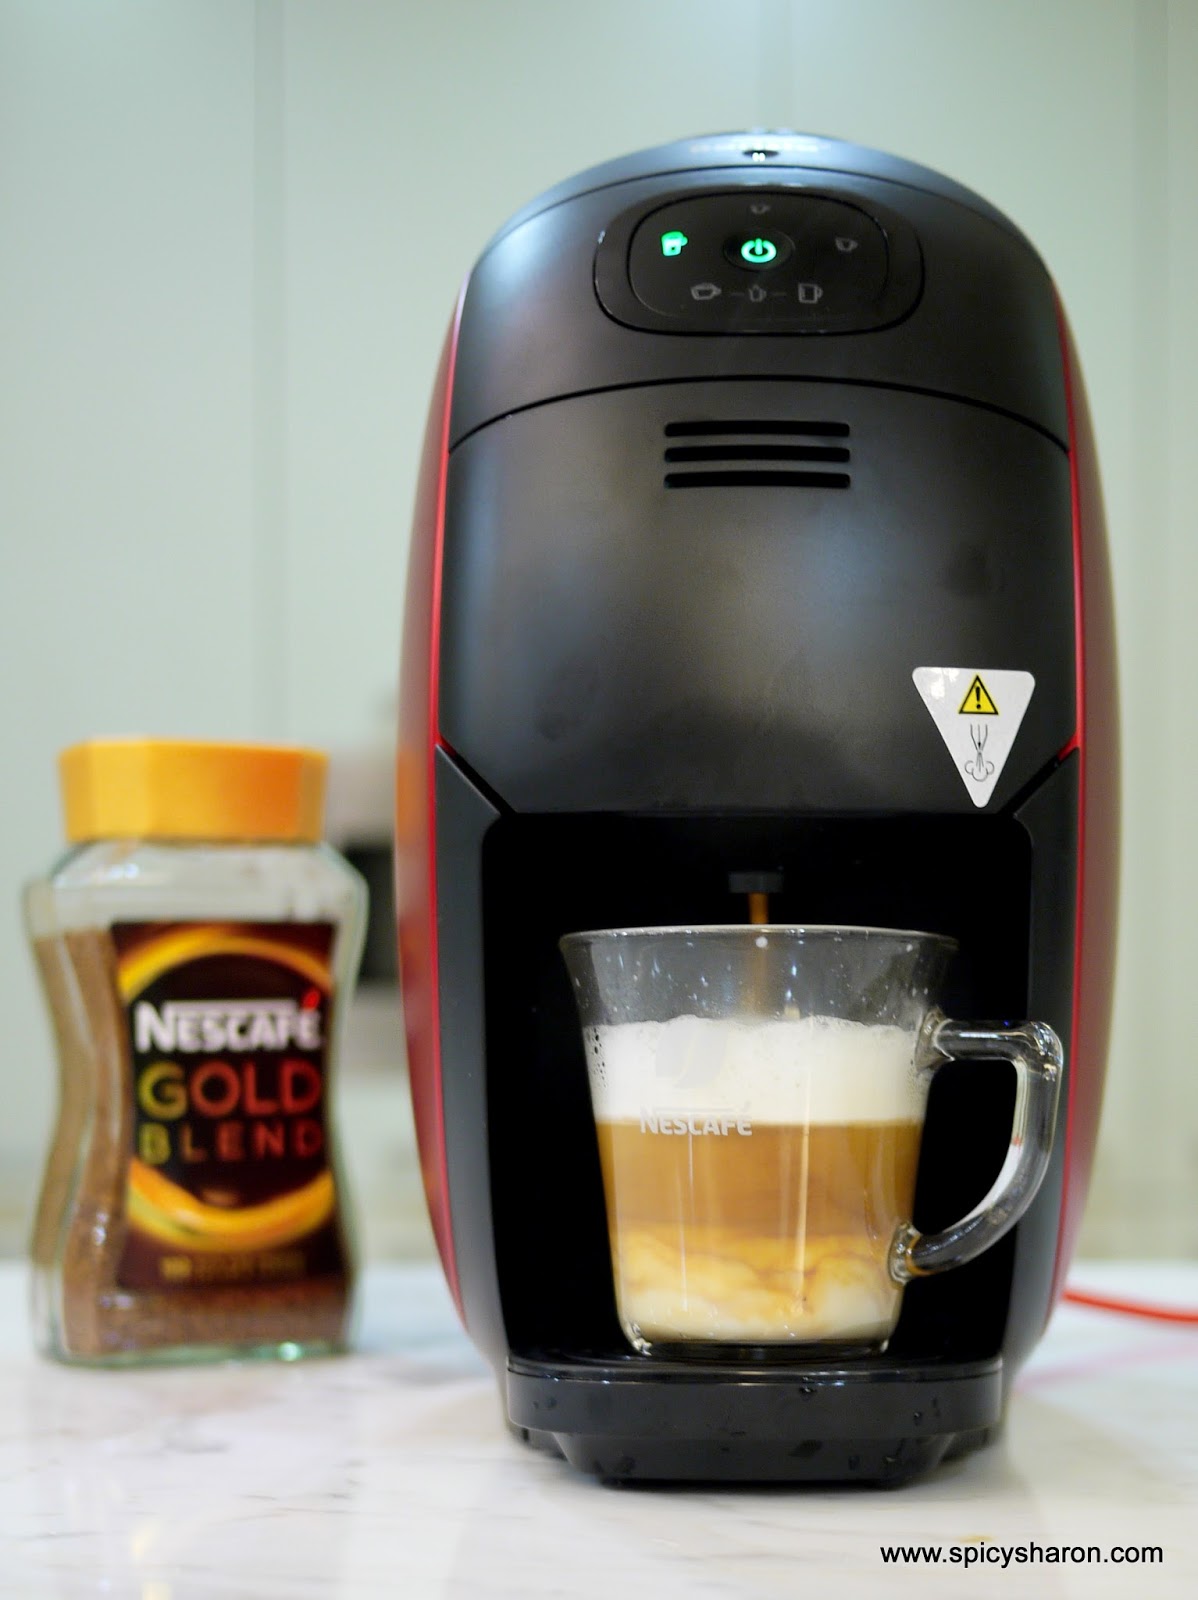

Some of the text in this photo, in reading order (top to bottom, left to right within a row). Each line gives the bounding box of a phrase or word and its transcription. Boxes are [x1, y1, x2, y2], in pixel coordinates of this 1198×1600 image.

[134, 987, 321, 1052] NESCAFÉ
[138, 1060, 321, 1120] GOLD
[138, 1119, 322, 1164] BLEND
